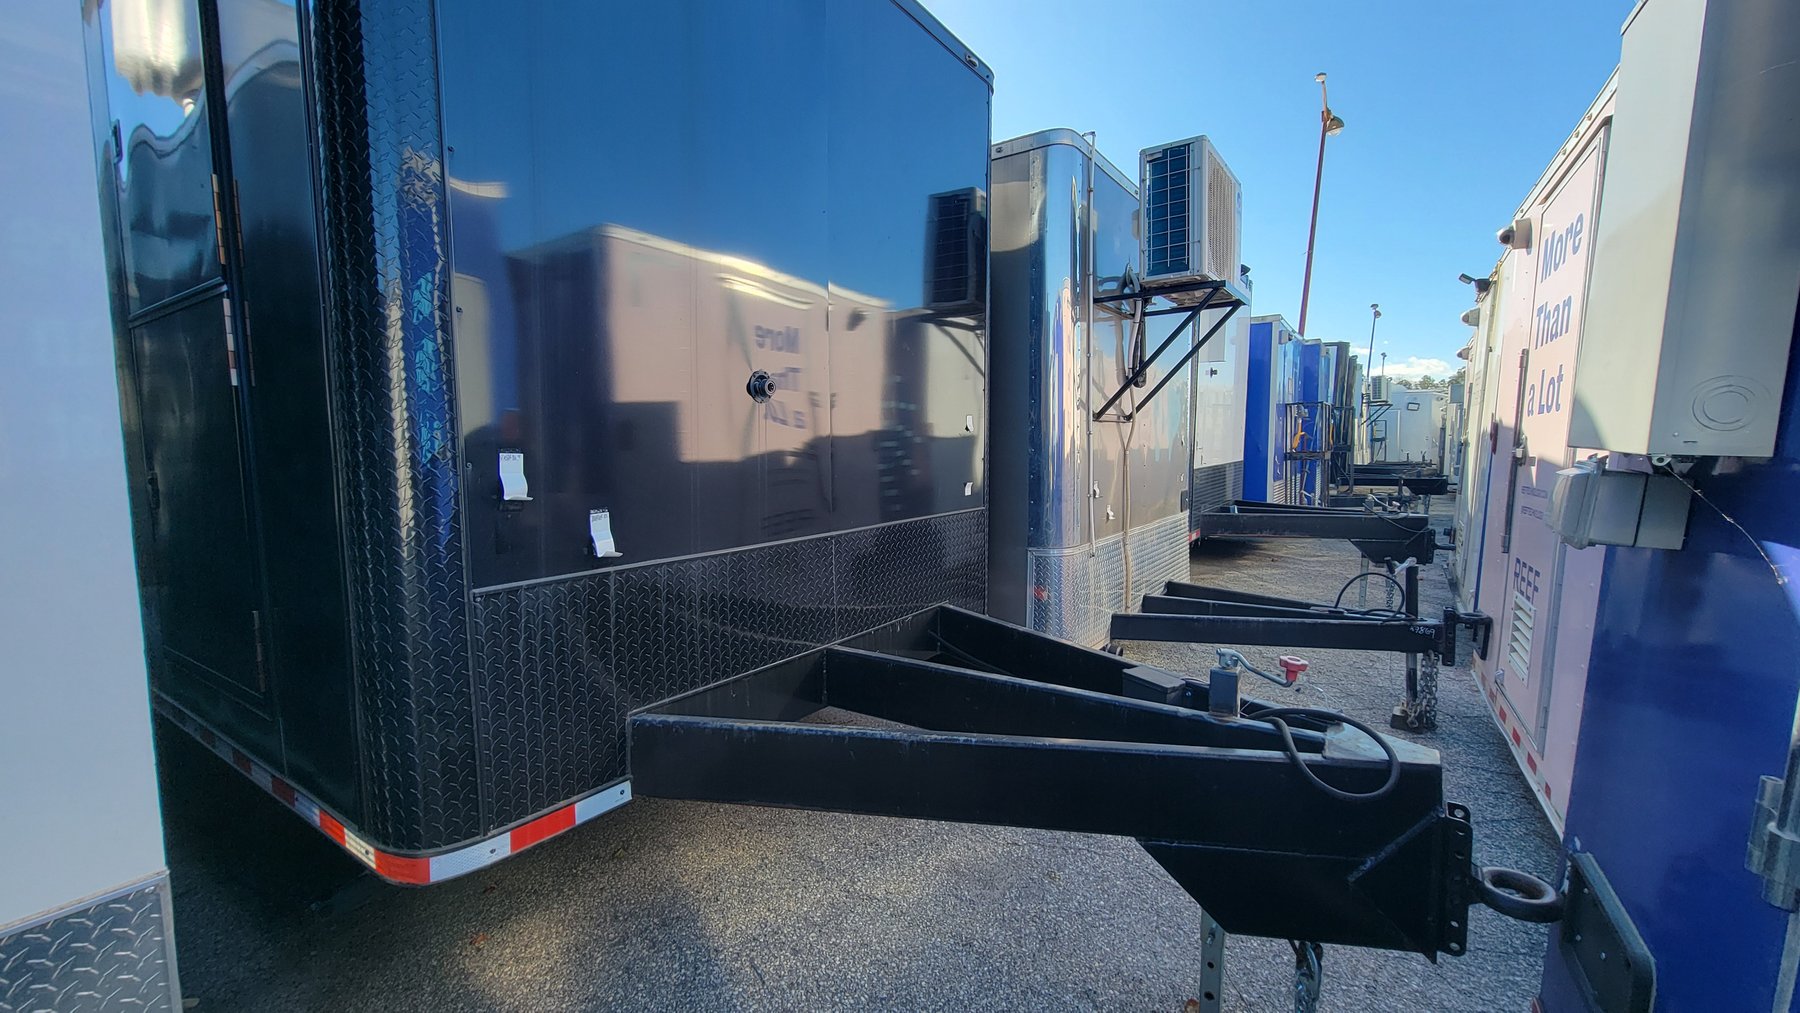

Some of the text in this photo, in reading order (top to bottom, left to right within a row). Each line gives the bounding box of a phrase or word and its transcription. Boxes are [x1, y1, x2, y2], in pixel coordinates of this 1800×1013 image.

[1540, 212, 1584, 283] More
[1534, 295, 1573, 350] Than
[1527, 382, 1536, 418] a
[1537, 363, 1565, 415] Lot
[1513, 557, 1541, 605] REEF
